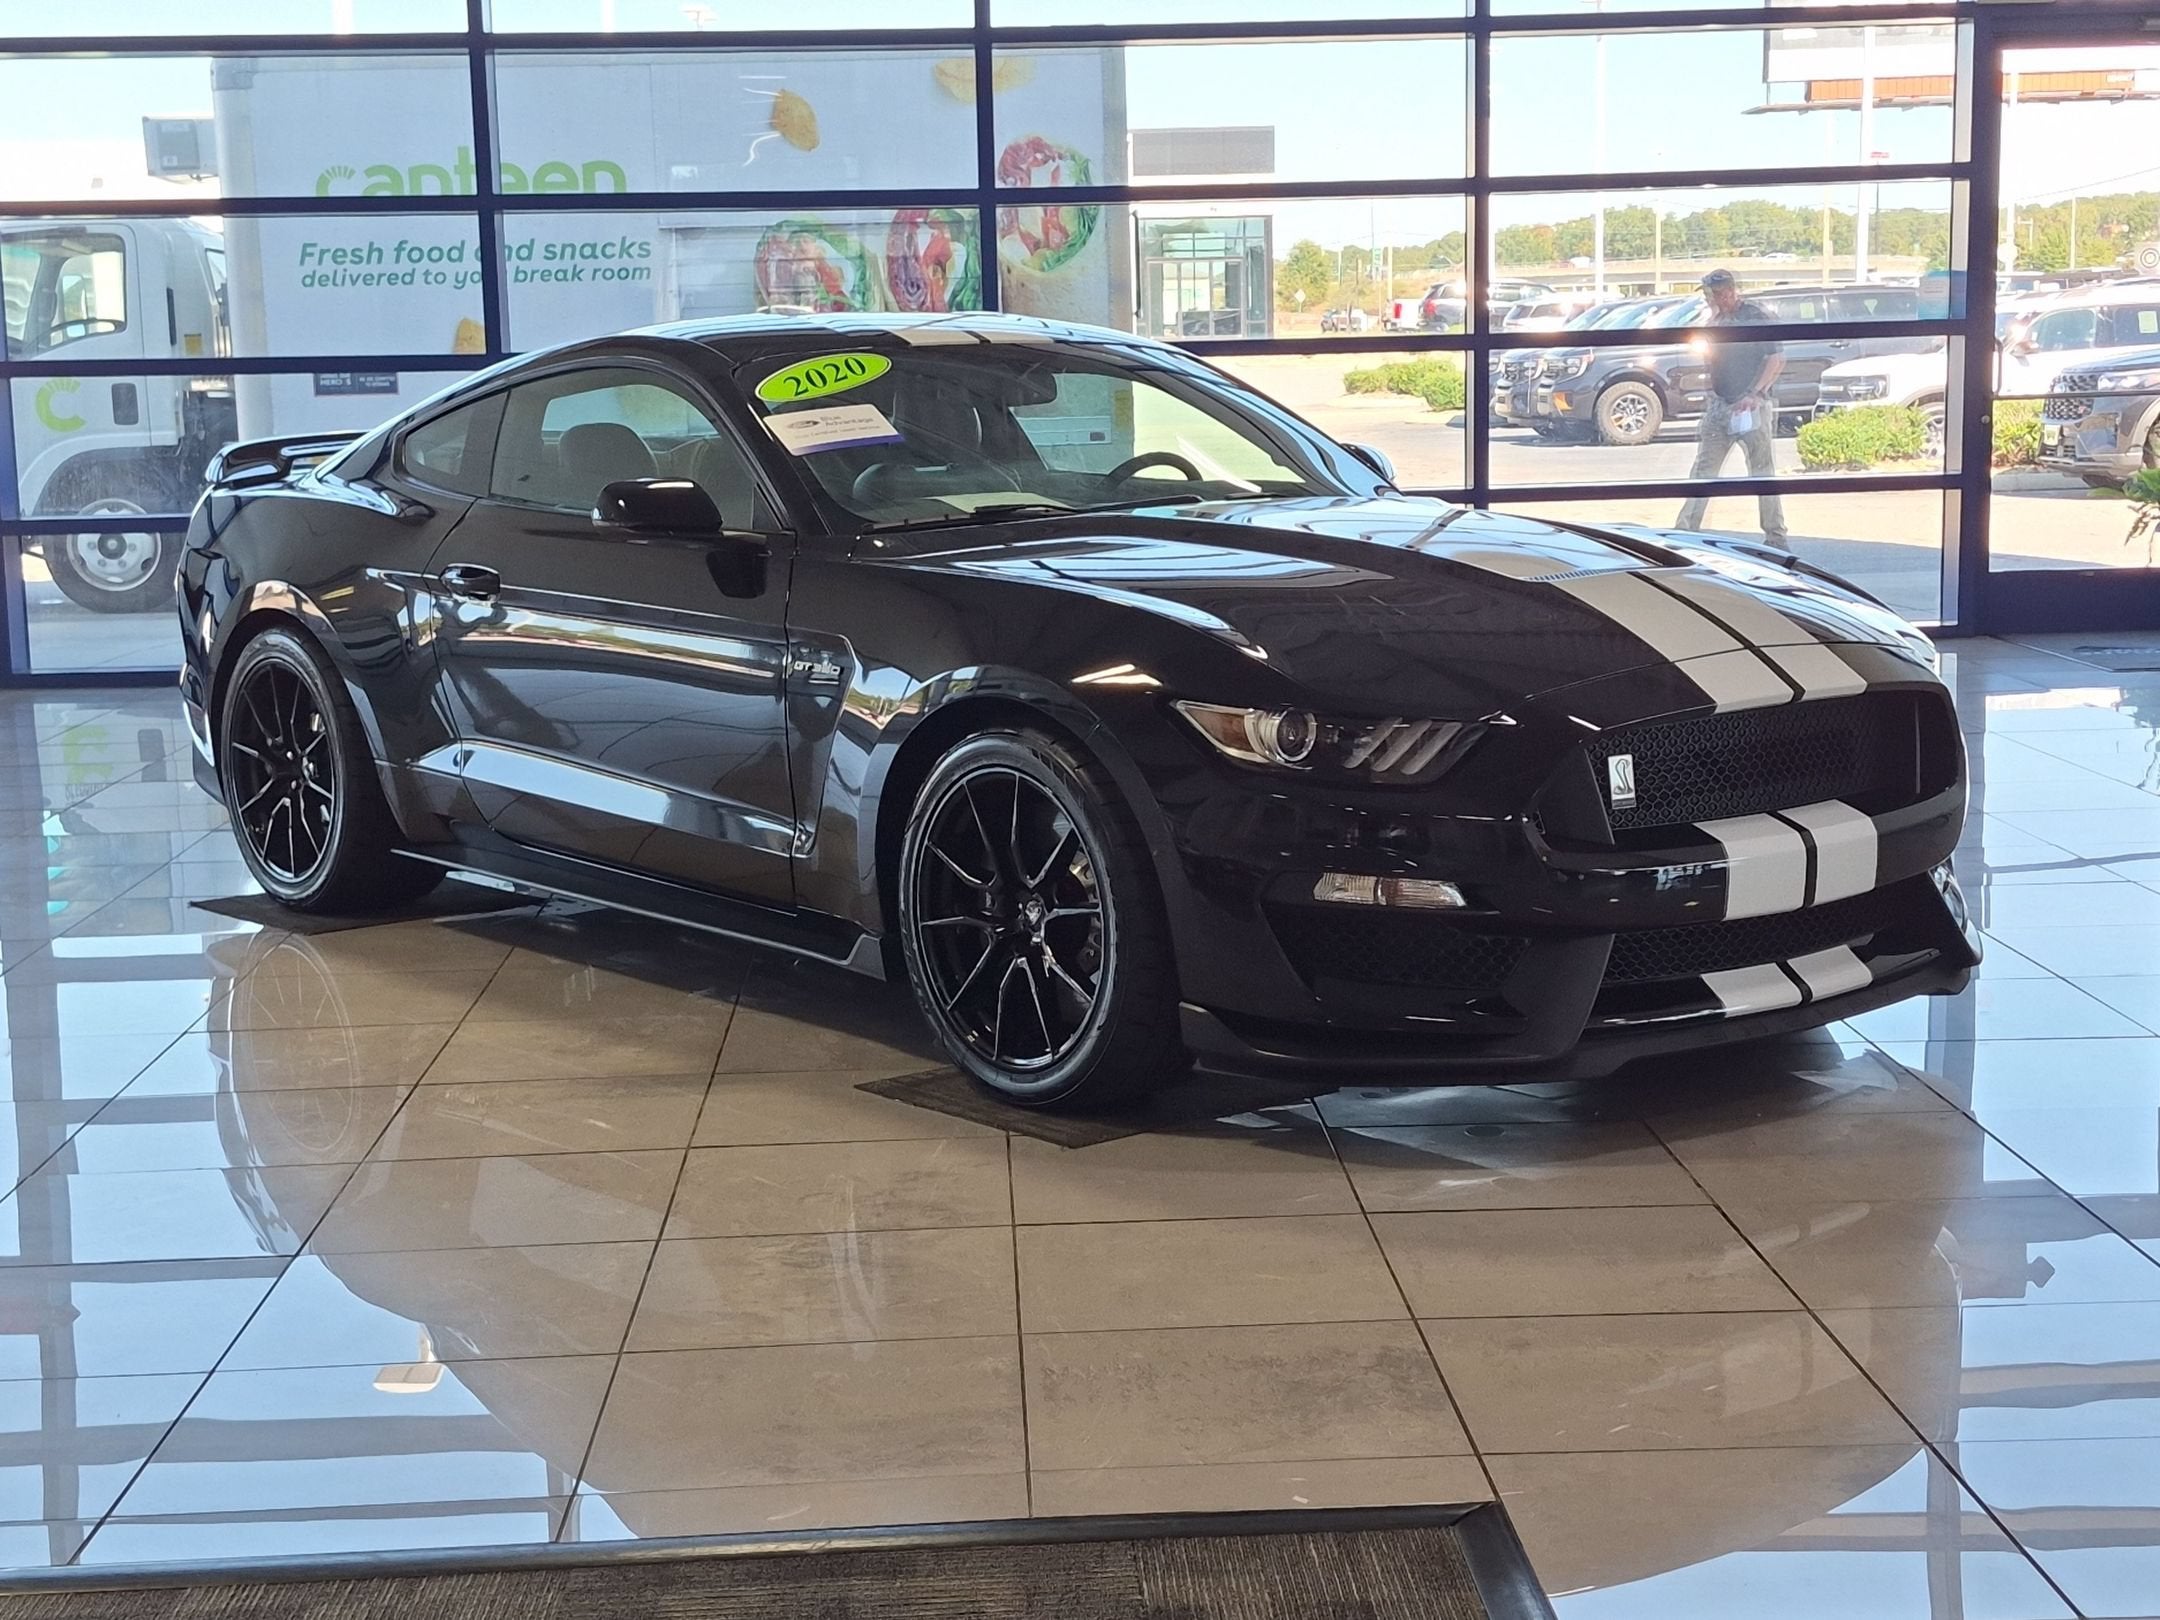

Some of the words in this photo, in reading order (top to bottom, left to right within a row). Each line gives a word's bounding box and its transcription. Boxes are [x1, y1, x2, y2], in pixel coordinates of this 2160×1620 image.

[299, 241, 384, 266] Fresh
[393, 239, 466, 265] food
[543, 236, 652, 261] snacks
[301, 268, 416, 288] delivered
[422, 269, 447, 285] to
[513, 264, 585, 283] break
[591, 266, 652, 281] room
[783, 356, 866, 397] 2020
